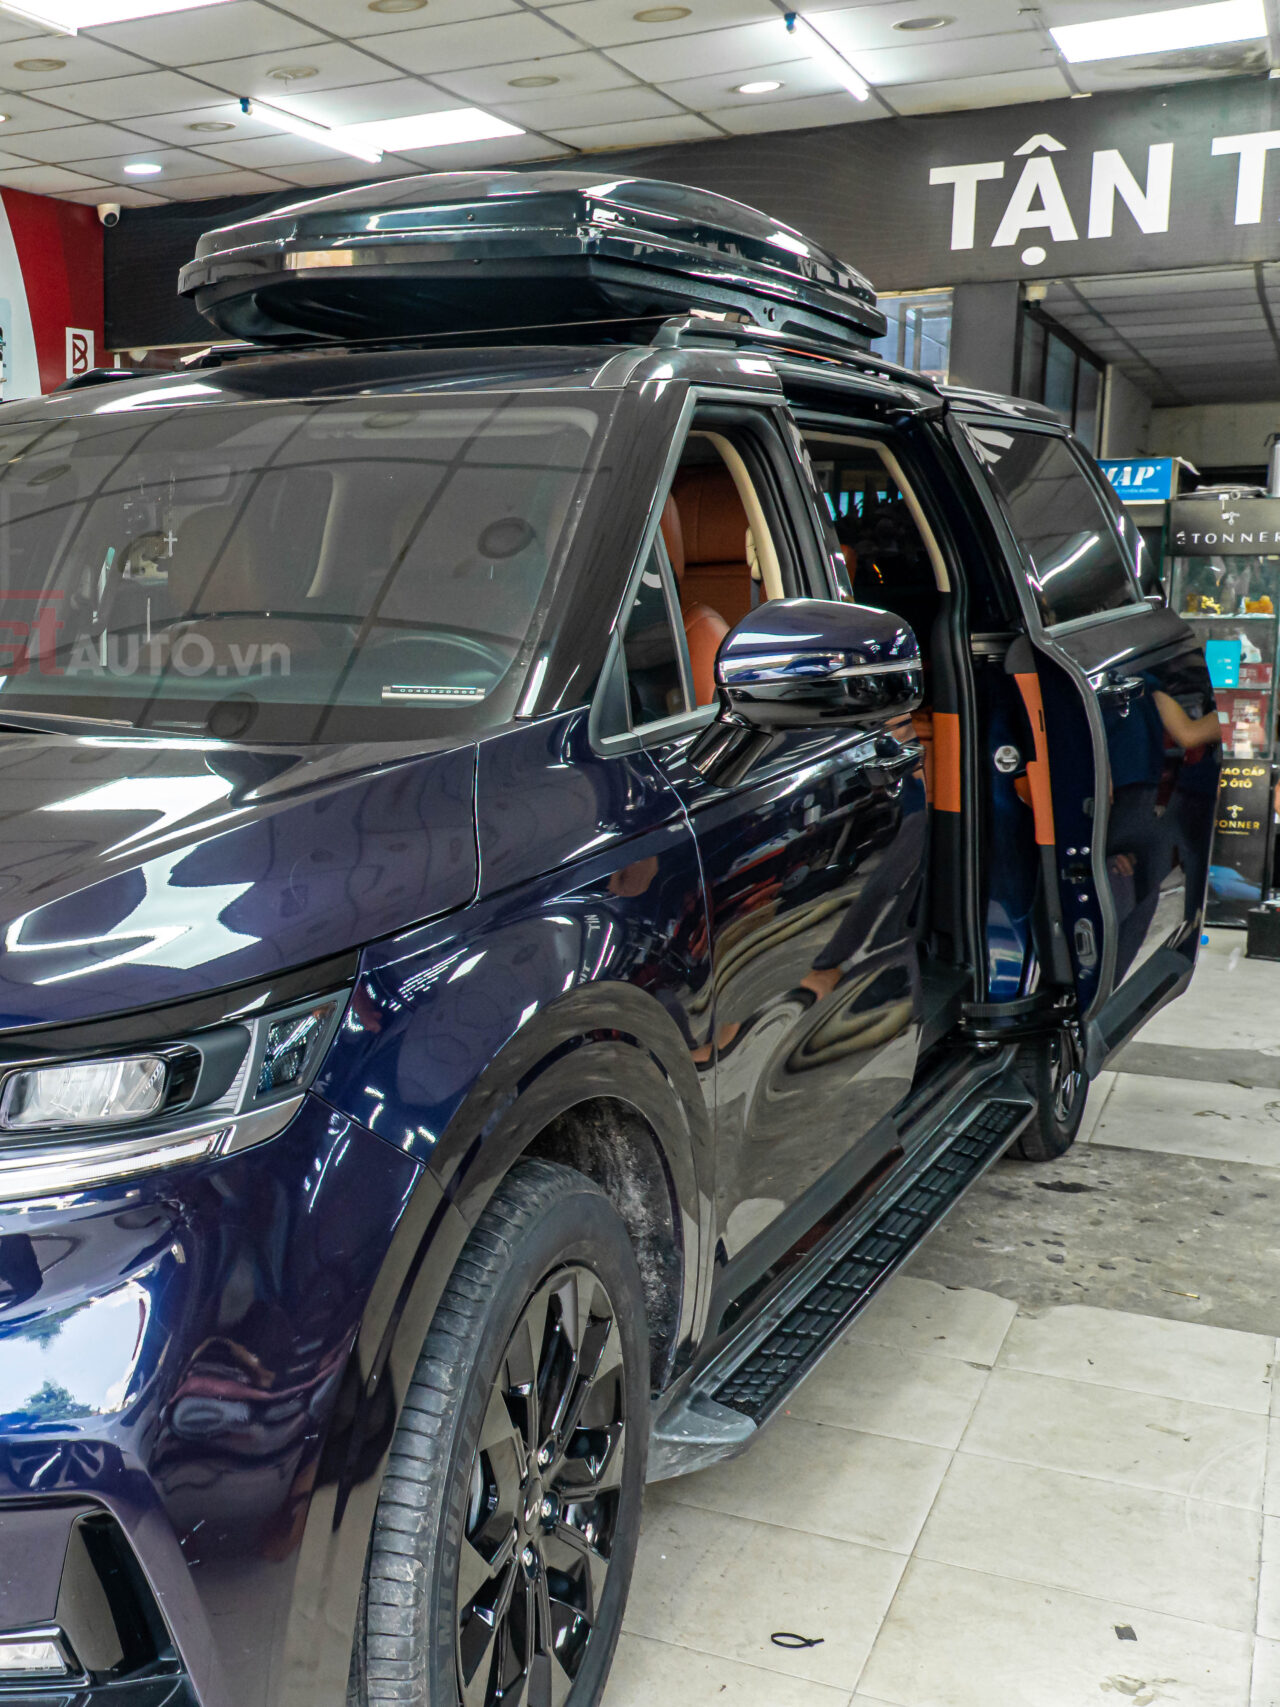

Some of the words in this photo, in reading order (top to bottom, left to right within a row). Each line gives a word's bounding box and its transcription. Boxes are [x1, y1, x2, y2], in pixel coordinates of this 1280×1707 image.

[928, 133, 1174, 266] TẬN
[1211, 130, 1280, 226] T
[1215, 819, 1261, 830] ONNER
